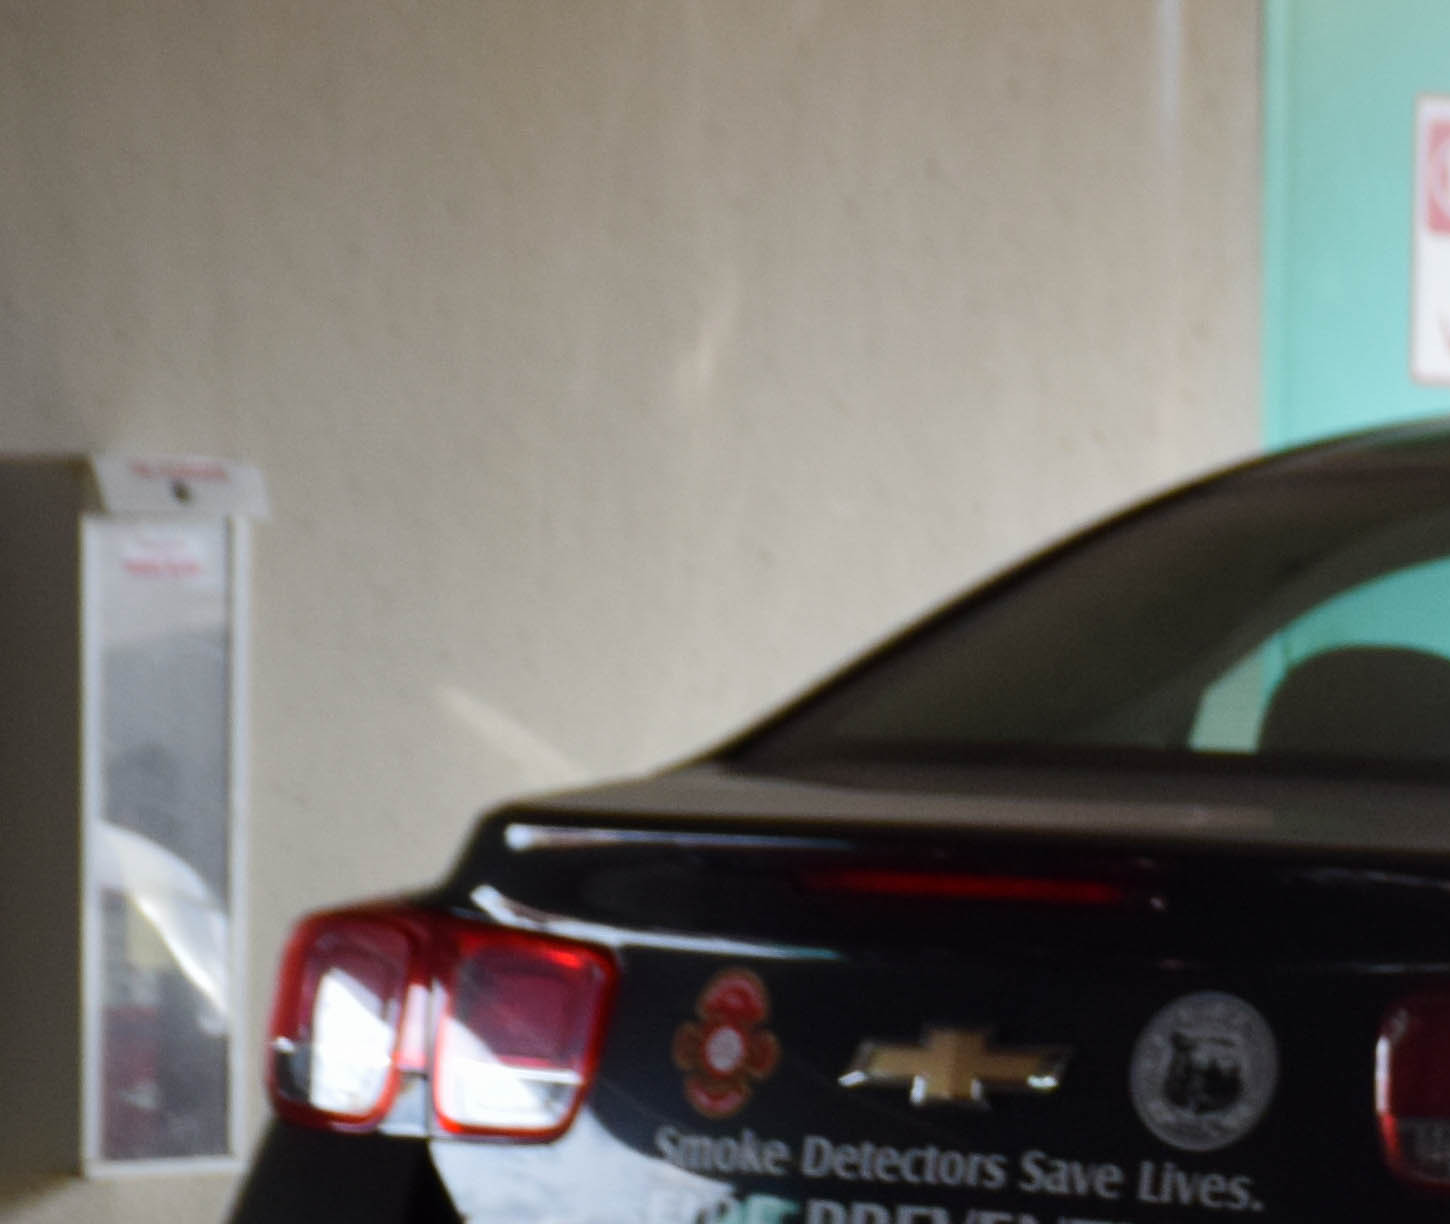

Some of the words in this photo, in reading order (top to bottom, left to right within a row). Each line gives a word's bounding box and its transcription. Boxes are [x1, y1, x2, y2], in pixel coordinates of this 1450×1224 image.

[653, 1125, 791, 1176] Smoke
[799, 1134, 1006, 1190] Detectors
[1019, 1149, 1124, 1199] Save
[1138, 1160, 1264, 1212] Lives.
